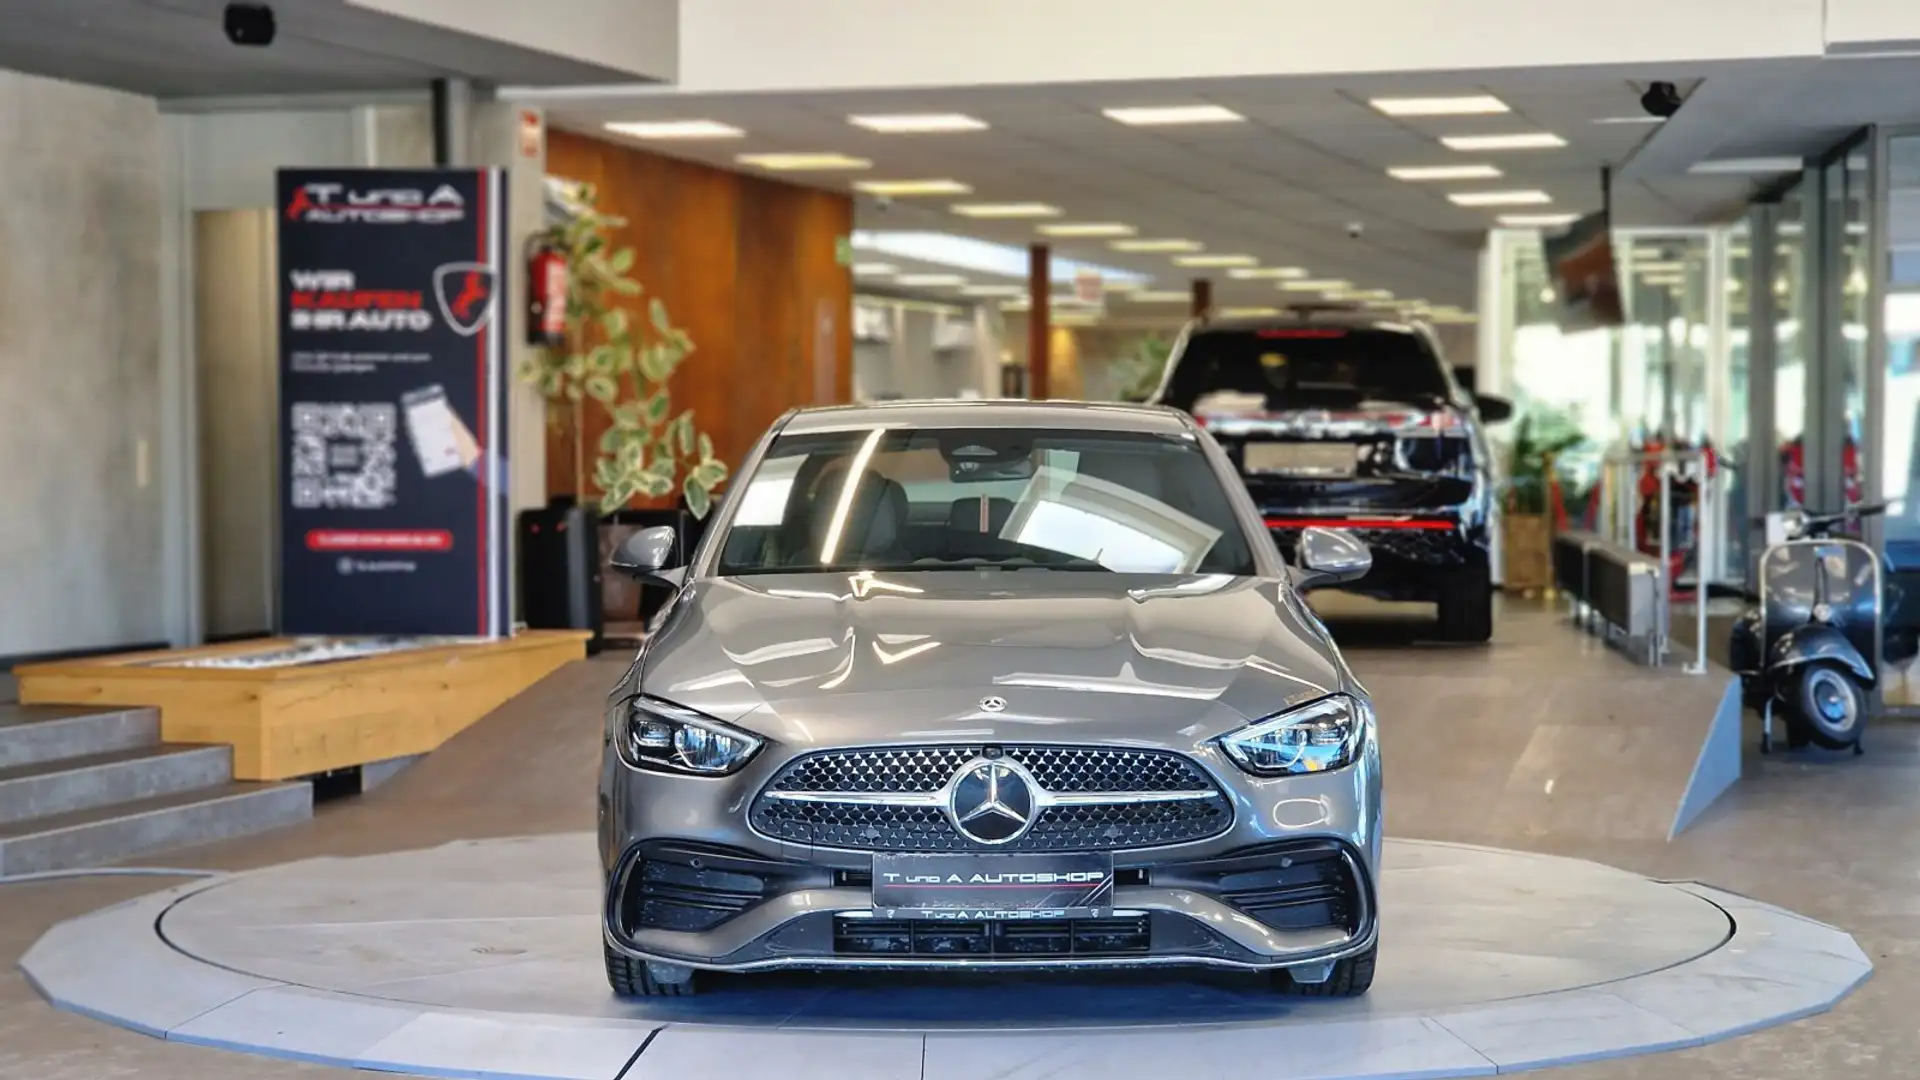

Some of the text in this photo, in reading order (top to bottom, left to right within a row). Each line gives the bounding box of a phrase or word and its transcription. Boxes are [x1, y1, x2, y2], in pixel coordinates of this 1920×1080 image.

[290, 270, 355, 290] WIR
[291, 290, 422, 310] KAUFEN
[349, 310, 432, 331] AUTO
[883, 873, 900, 882] T
[946, 873, 963, 883] A
[969, 872, 1104, 884] AUTOSHOP
[974, 910, 1065, 919] AUTOSHOP
